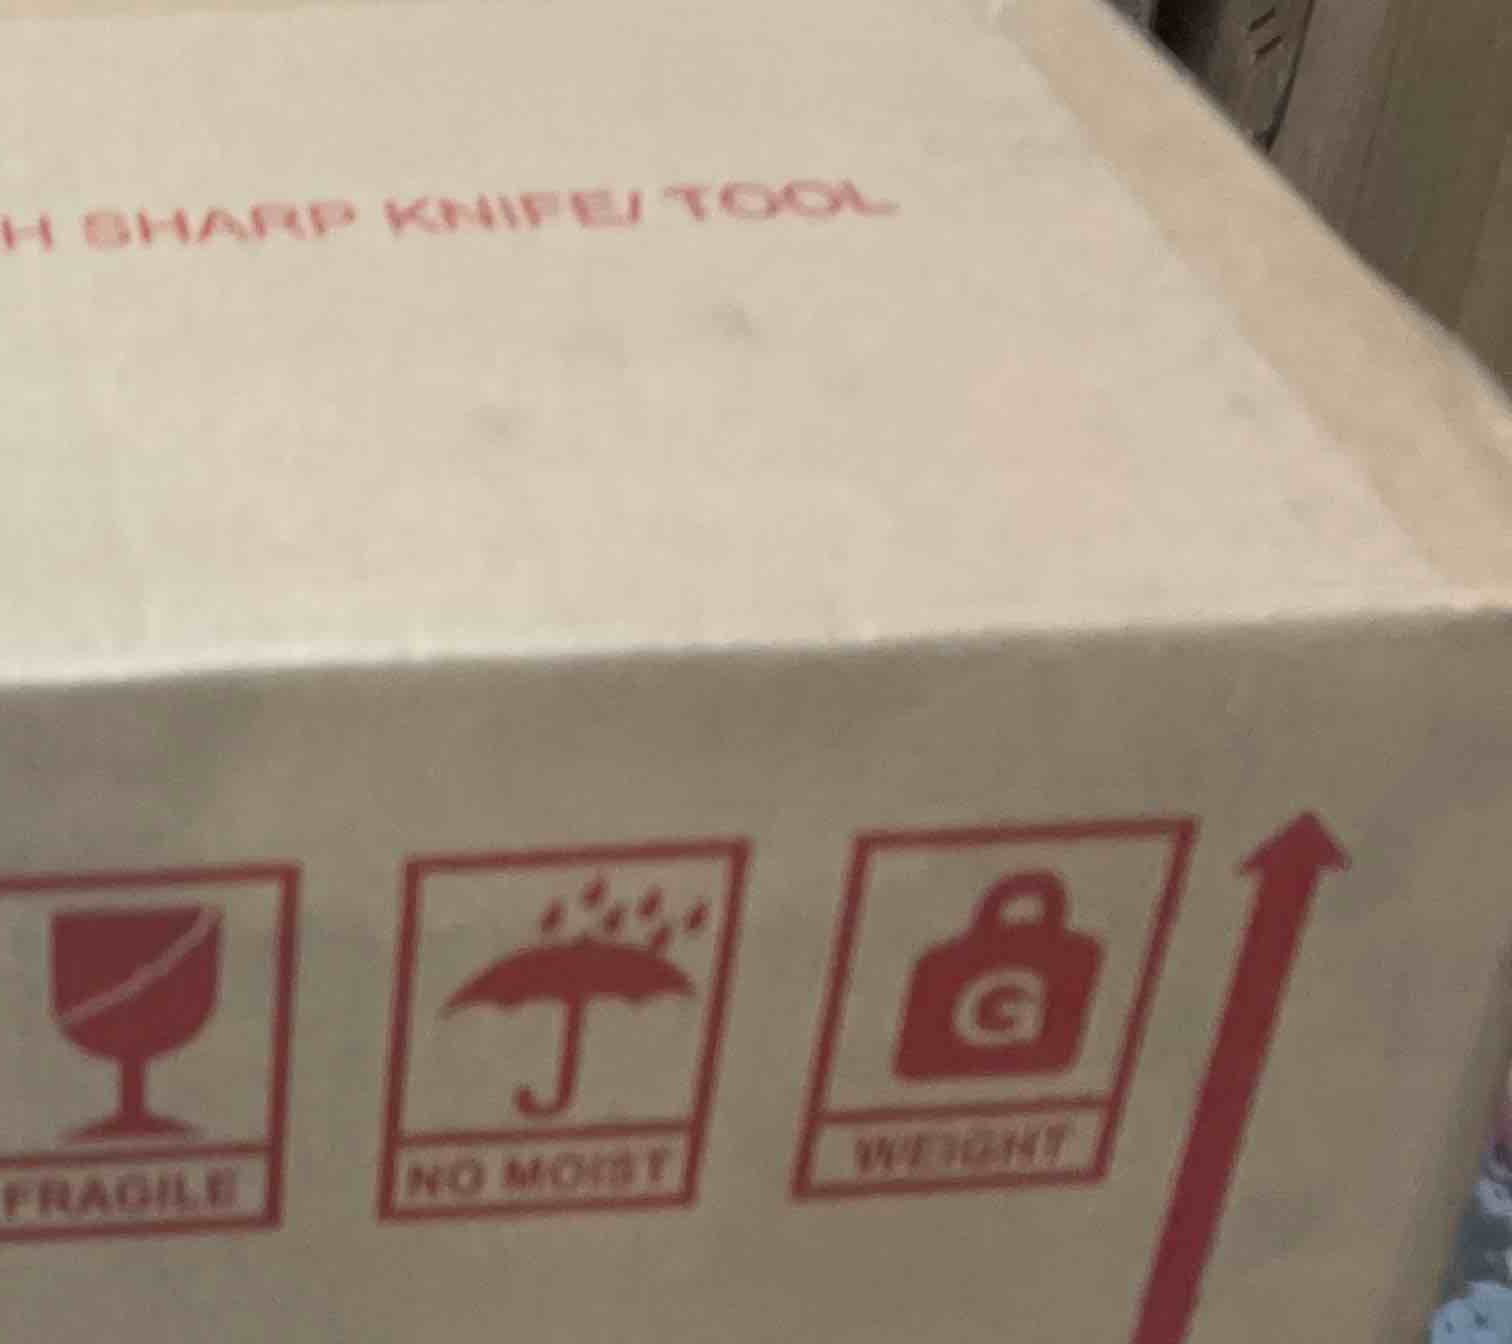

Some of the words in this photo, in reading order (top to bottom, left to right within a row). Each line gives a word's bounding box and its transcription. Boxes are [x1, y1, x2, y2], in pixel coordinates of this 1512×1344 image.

[84, 199, 355, 251] SHARP
[664, 177, 899, 222] TOOL
[951, 966, 1047, 1048] G
[407, 1155, 488, 1198] NO
[854, 1122, 1073, 1174] WEIGHT
[3, 1165, 237, 1222] FRAGILE
